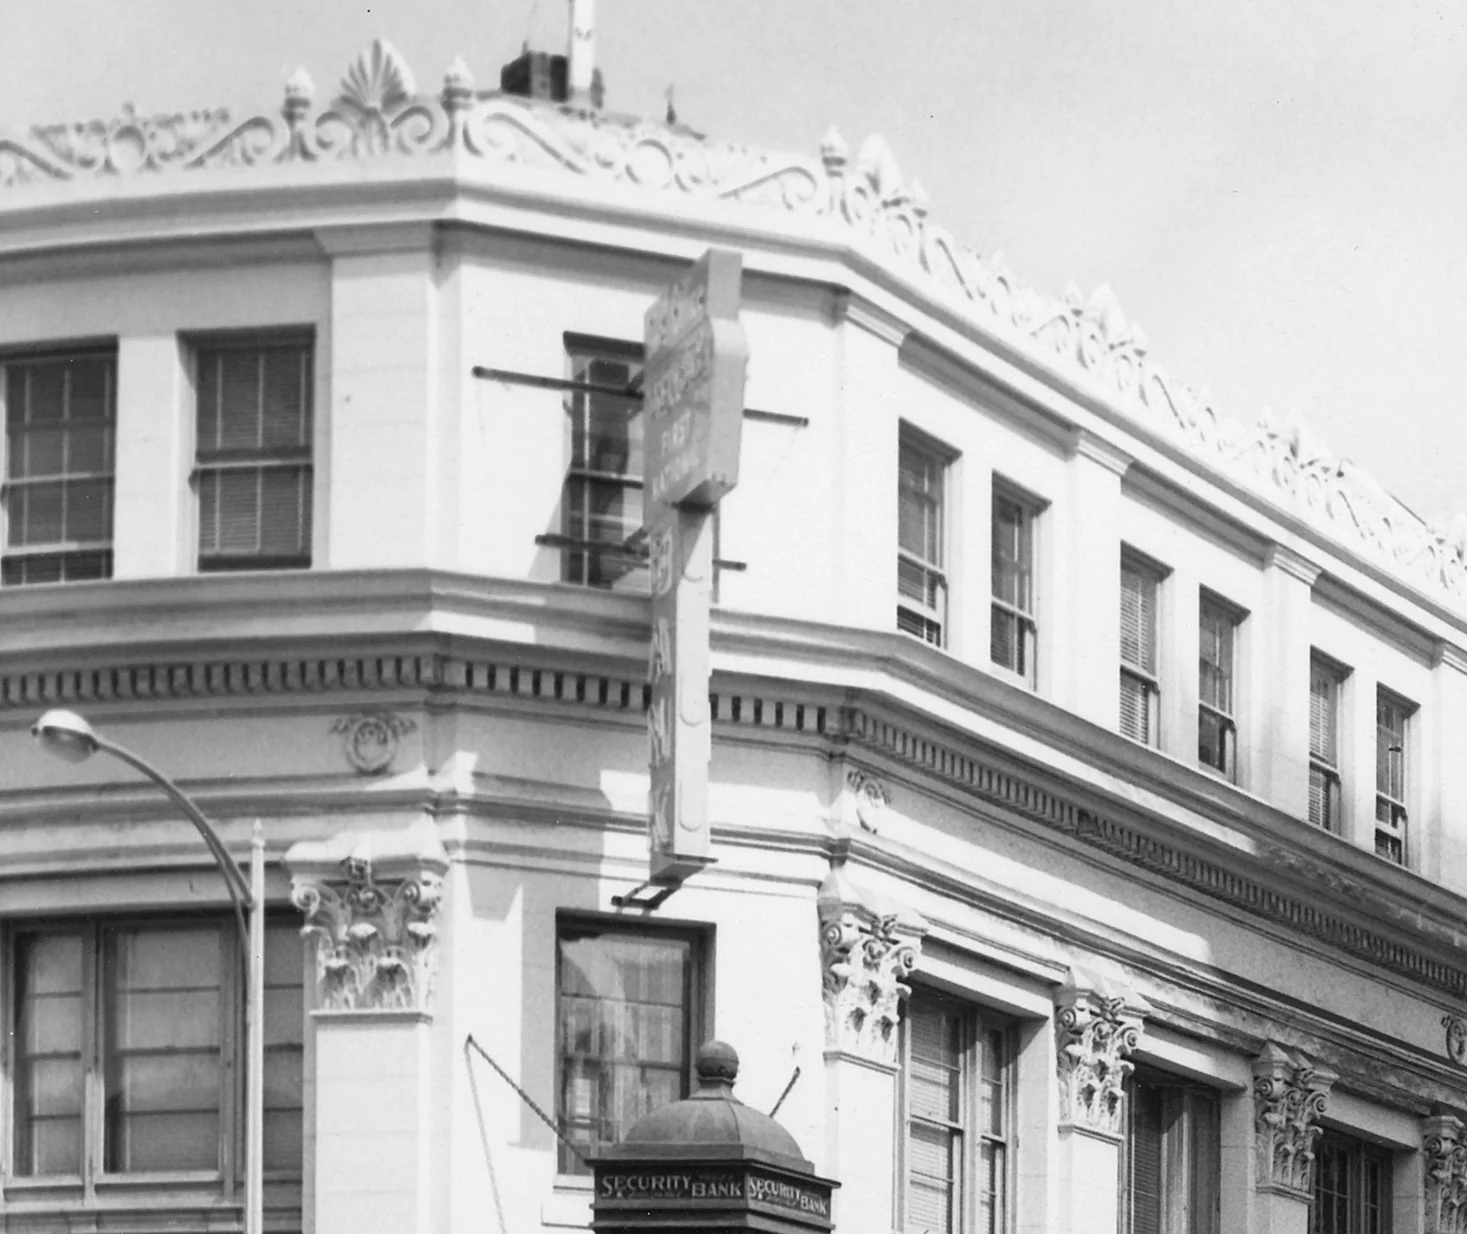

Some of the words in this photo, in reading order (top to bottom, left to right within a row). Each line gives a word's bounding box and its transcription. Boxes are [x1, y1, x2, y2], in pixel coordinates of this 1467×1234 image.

[601, 1174, 692, 1199] SECURITY
[691, 1182, 743, 1198] BANK
[800, 1194, 828, 1216] BANK
